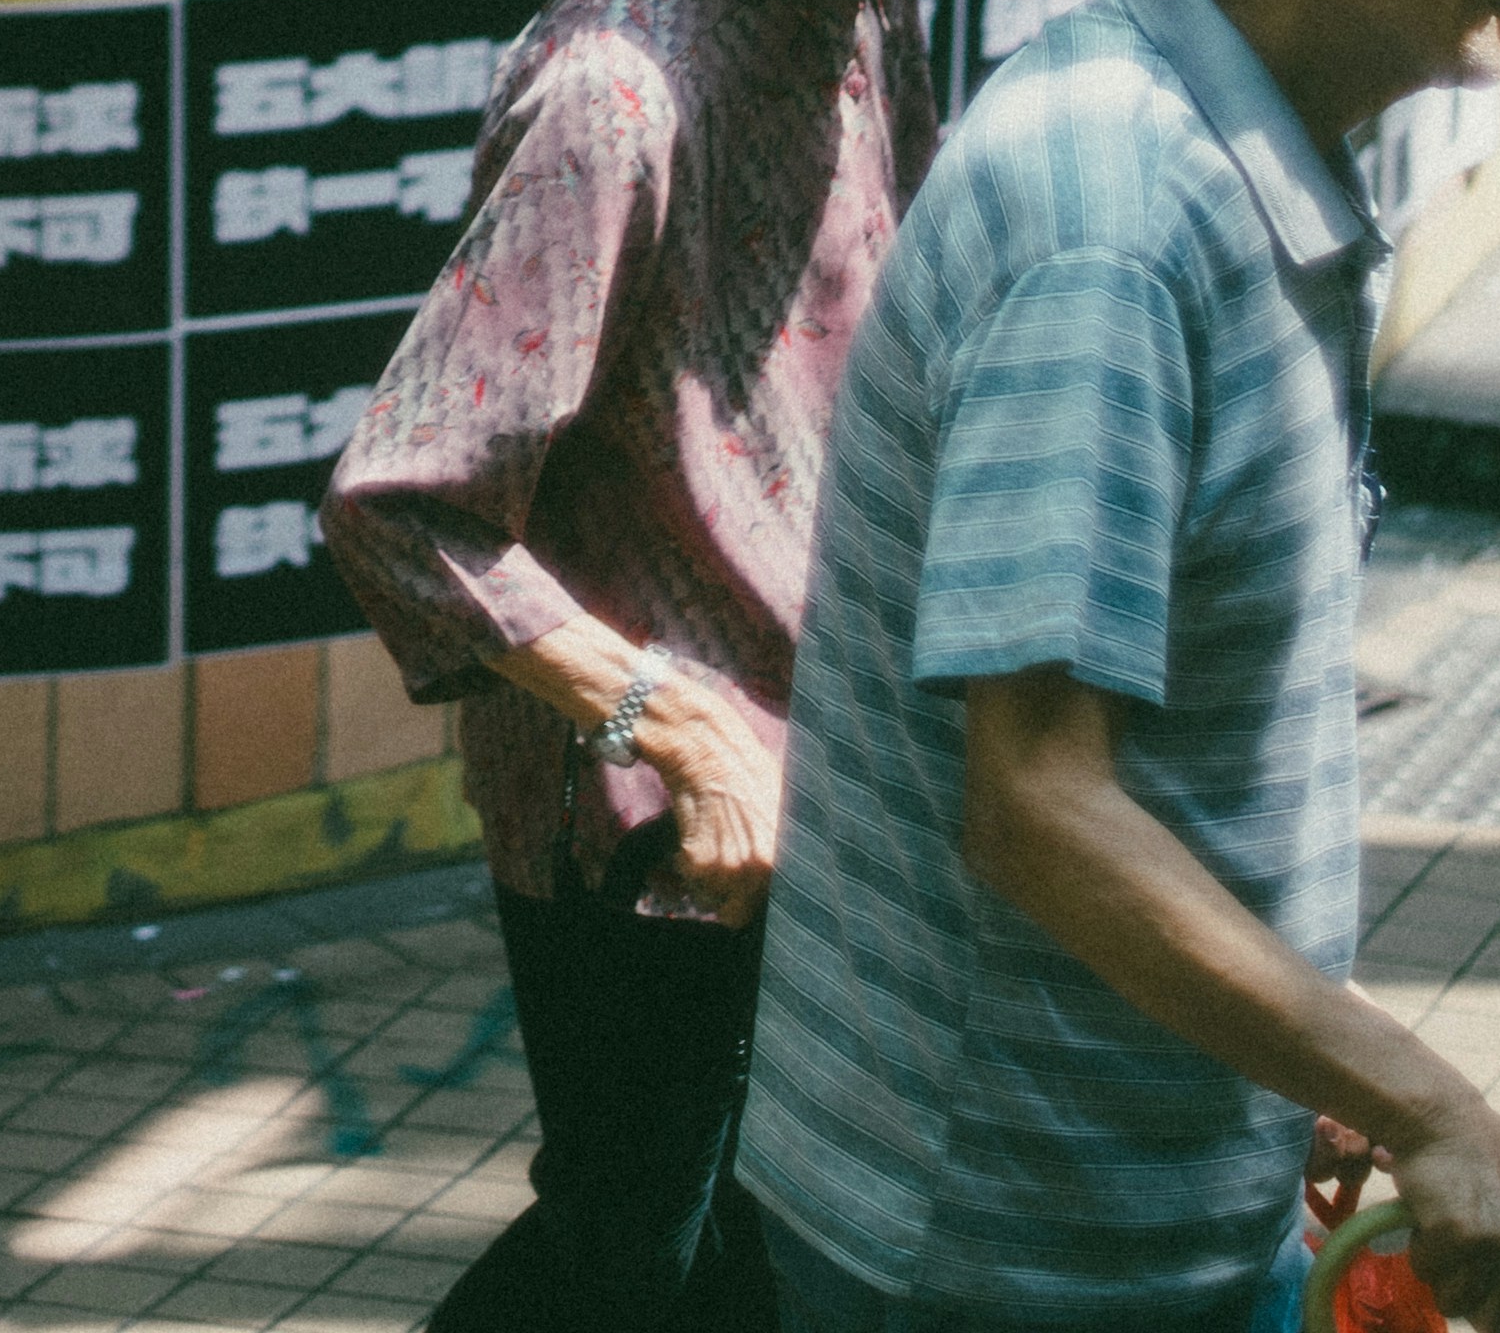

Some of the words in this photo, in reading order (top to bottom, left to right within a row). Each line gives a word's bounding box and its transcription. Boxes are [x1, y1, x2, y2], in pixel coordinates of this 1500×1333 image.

[214, 36, 508, 136] 五大訴
[215, 148, 478, 241] 缺一不
